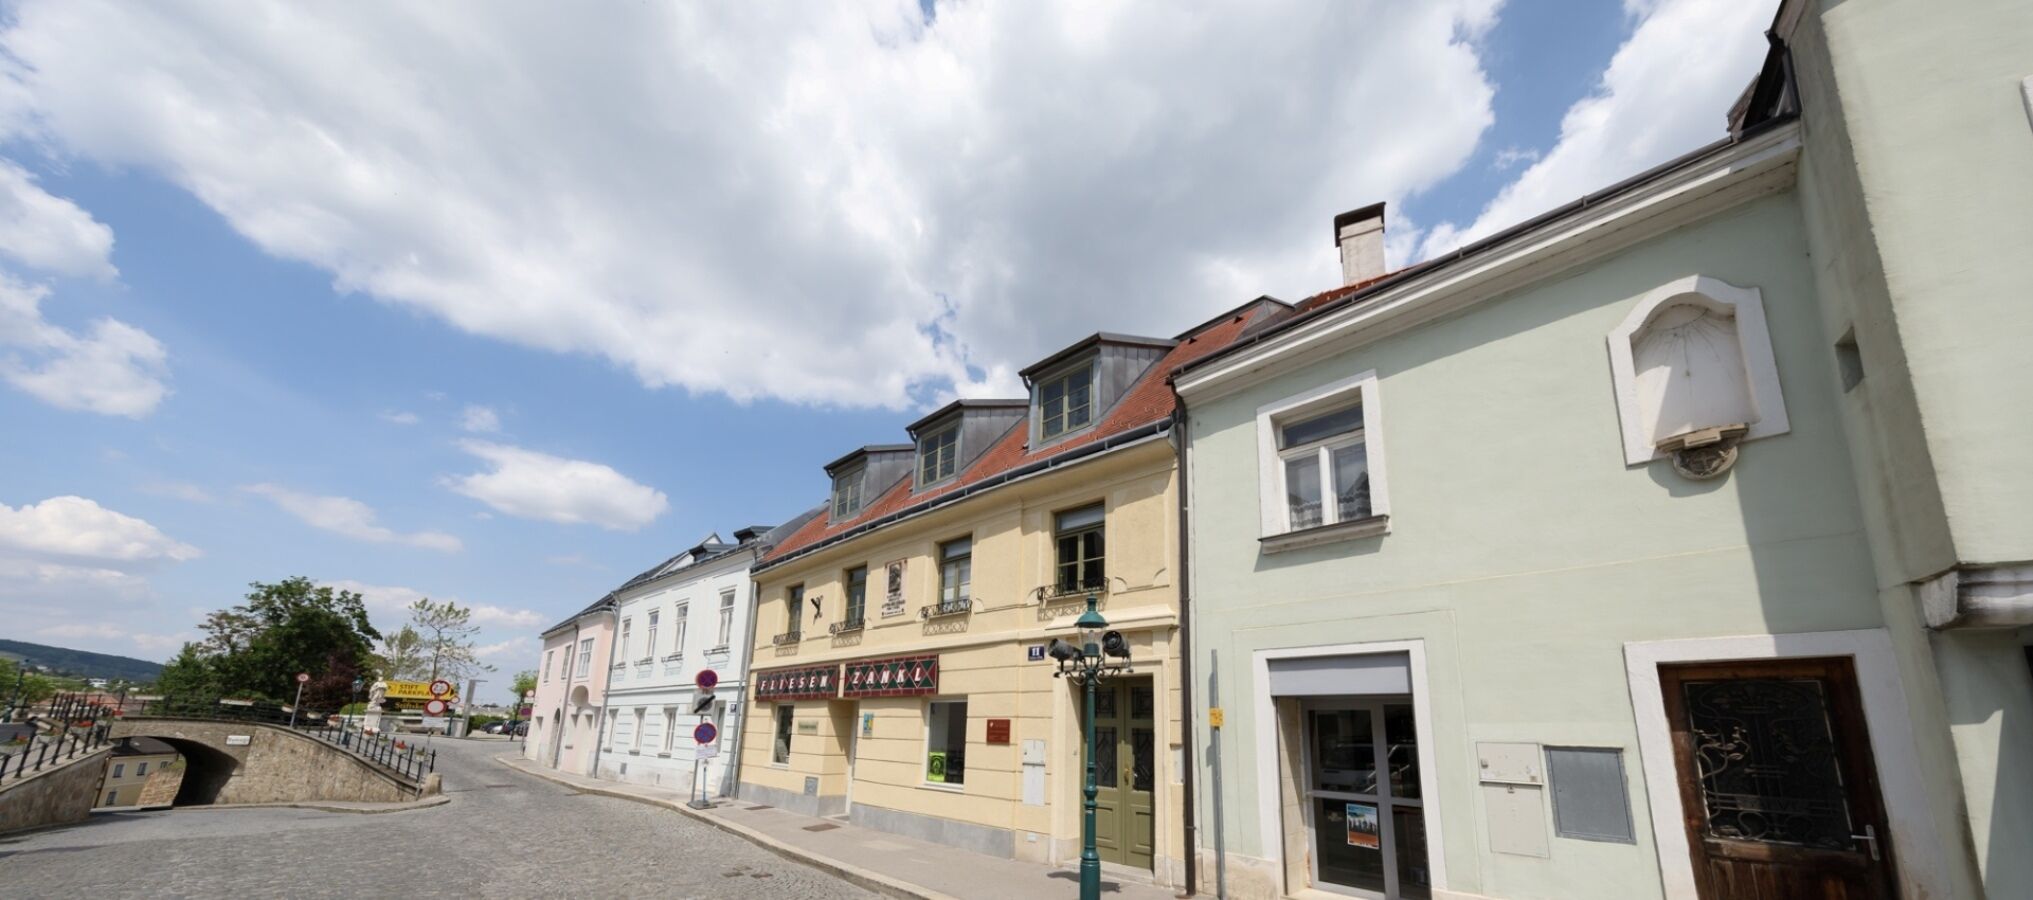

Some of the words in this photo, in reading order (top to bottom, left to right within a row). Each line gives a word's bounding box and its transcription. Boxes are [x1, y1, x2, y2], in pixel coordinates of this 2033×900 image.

[1032, 648, 1039, 656] 11
[760, 675, 828, 691] FLIESEN
[852, 667, 921, 684] ZANKL
